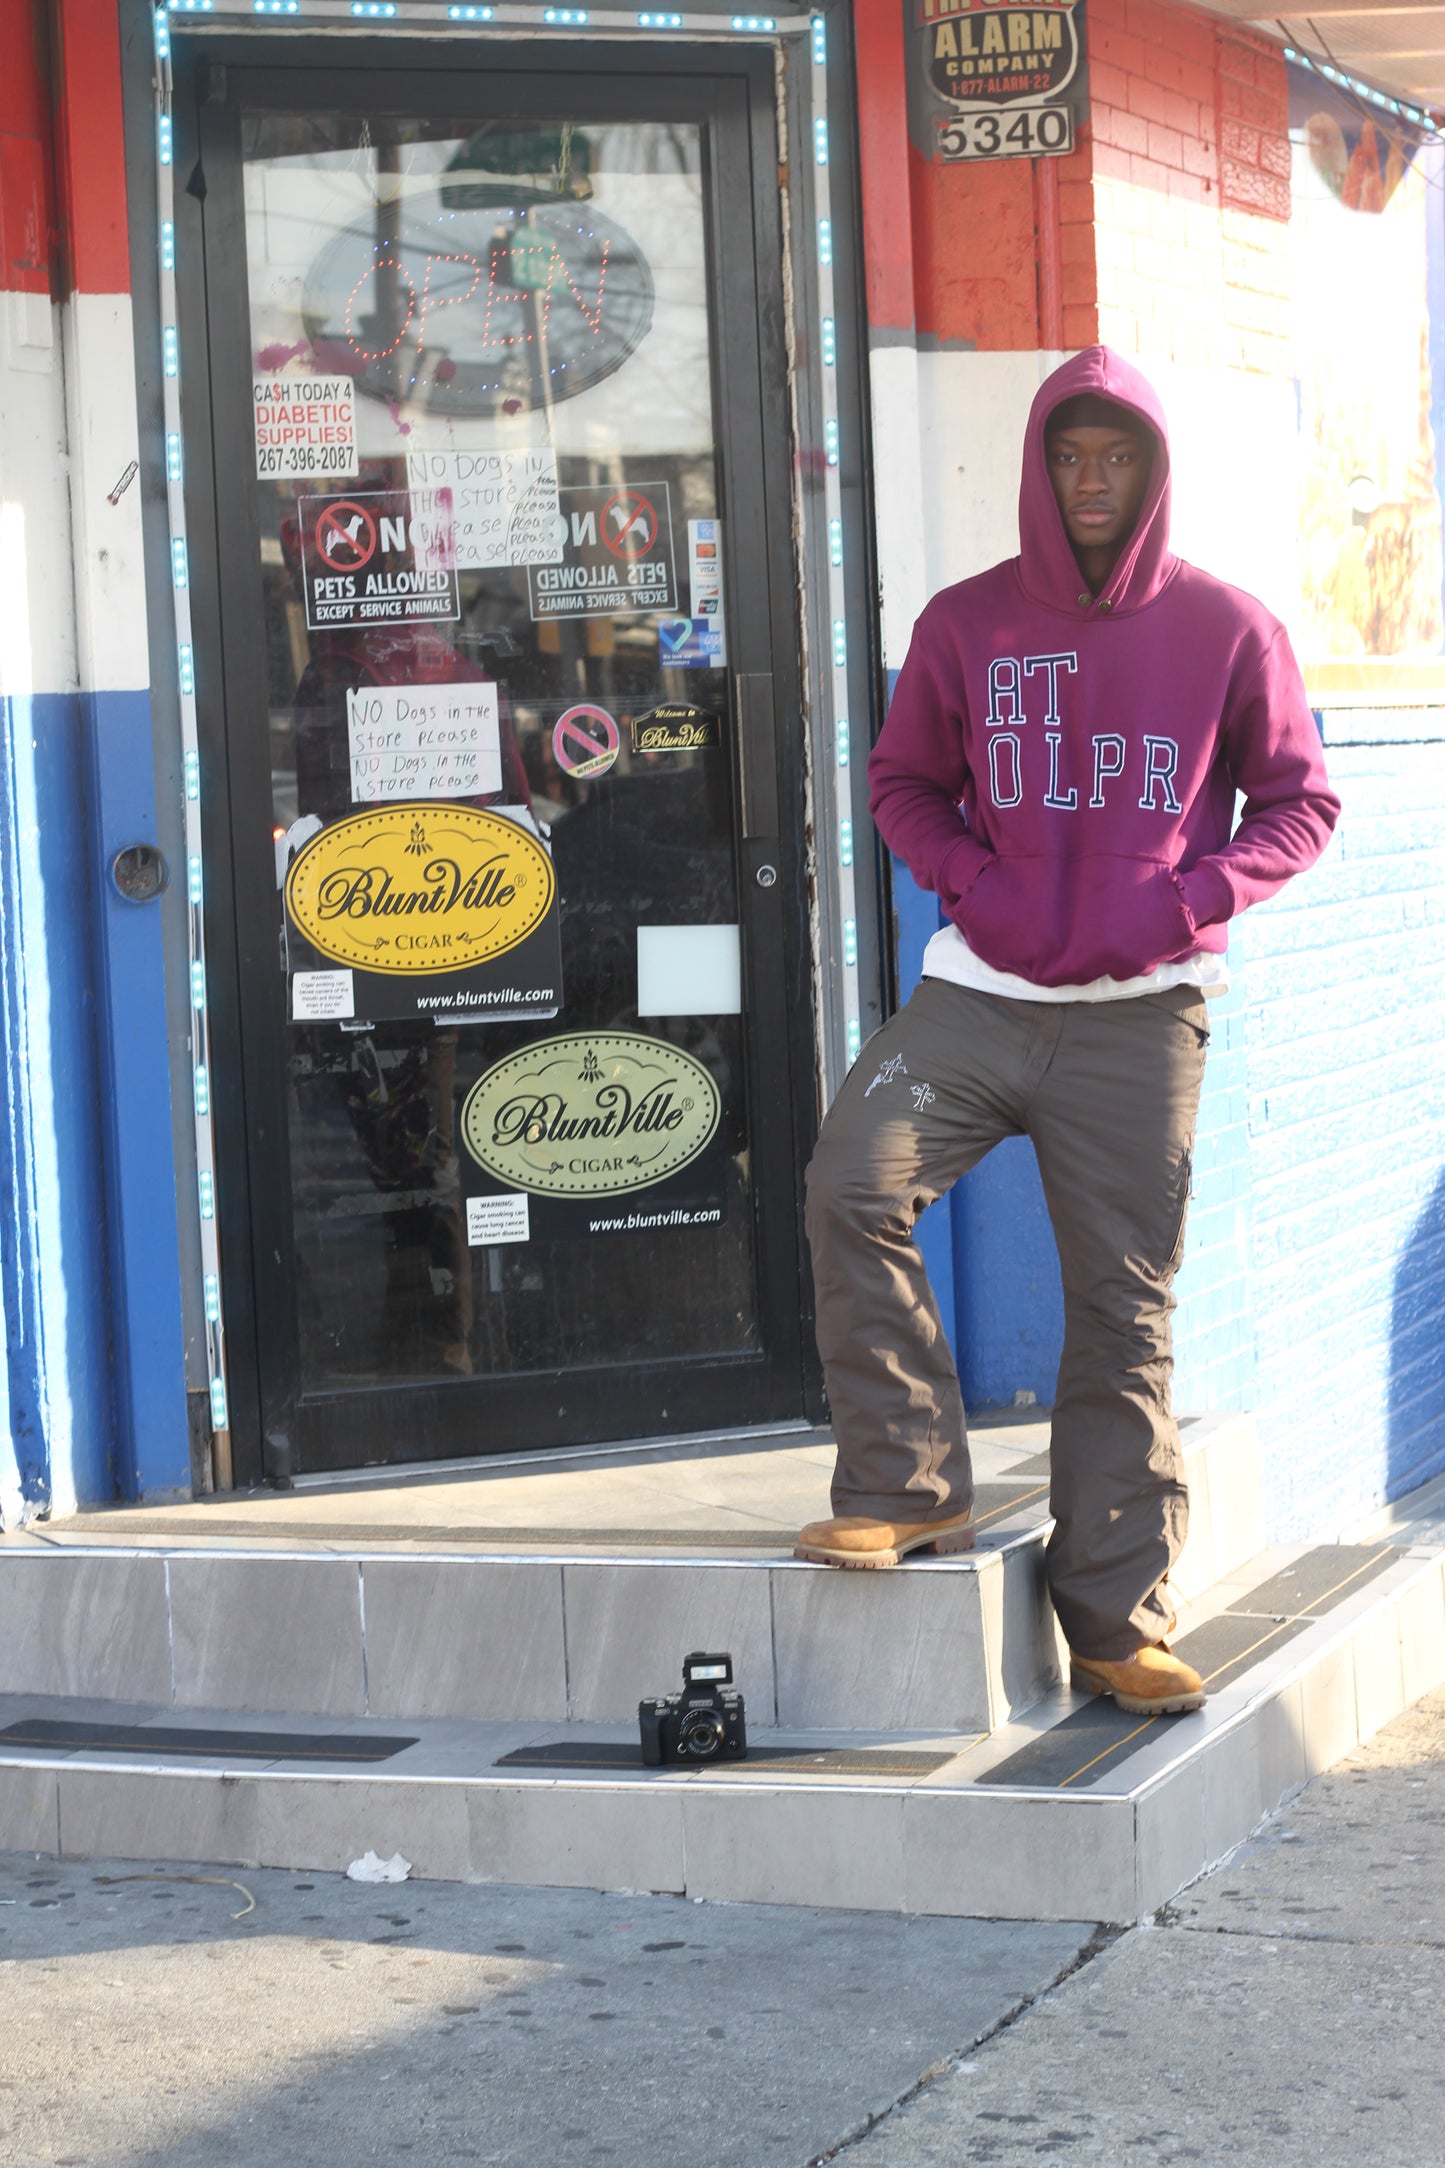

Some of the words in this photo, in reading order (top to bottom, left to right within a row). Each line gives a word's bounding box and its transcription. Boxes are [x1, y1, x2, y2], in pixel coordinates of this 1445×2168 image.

[934, 12, 1062, 59] ALARM
[946, 53, 1055, 76] COMPANY
[941, 110, 1068, 156] 5340
[345, 239, 610, 360] OPEN
[254, 382, 290, 404] CA$H
[294, 383, 340, 401] TODAY
[343, 382, 352, 399] 4
[256, 403, 352, 425] DIABETIC
[256, 426, 353, 446] SUPPLIES!
[258, 446, 354, 473] 267-396-2087
[409, 454, 446, 483] NO
[313, 575, 356, 600] PETS
[365, 570, 449, 596] ALLOWED
[316, 604, 355, 621] EXCEPT
[359, 601, 402, 618] SERVICE
[405, 599, 451, 615] ANIMALS
[985, 650, 1078, 727] AT
[351, 699, 383, 726] NO
[394, 933, 453, 951] CIGAR
[416, 986, 554, 1009] www.bluntville.com
[568, 1157, 624, 1175] CIGAR
[589, 1208, 721, 1233] www.bluntville.com
